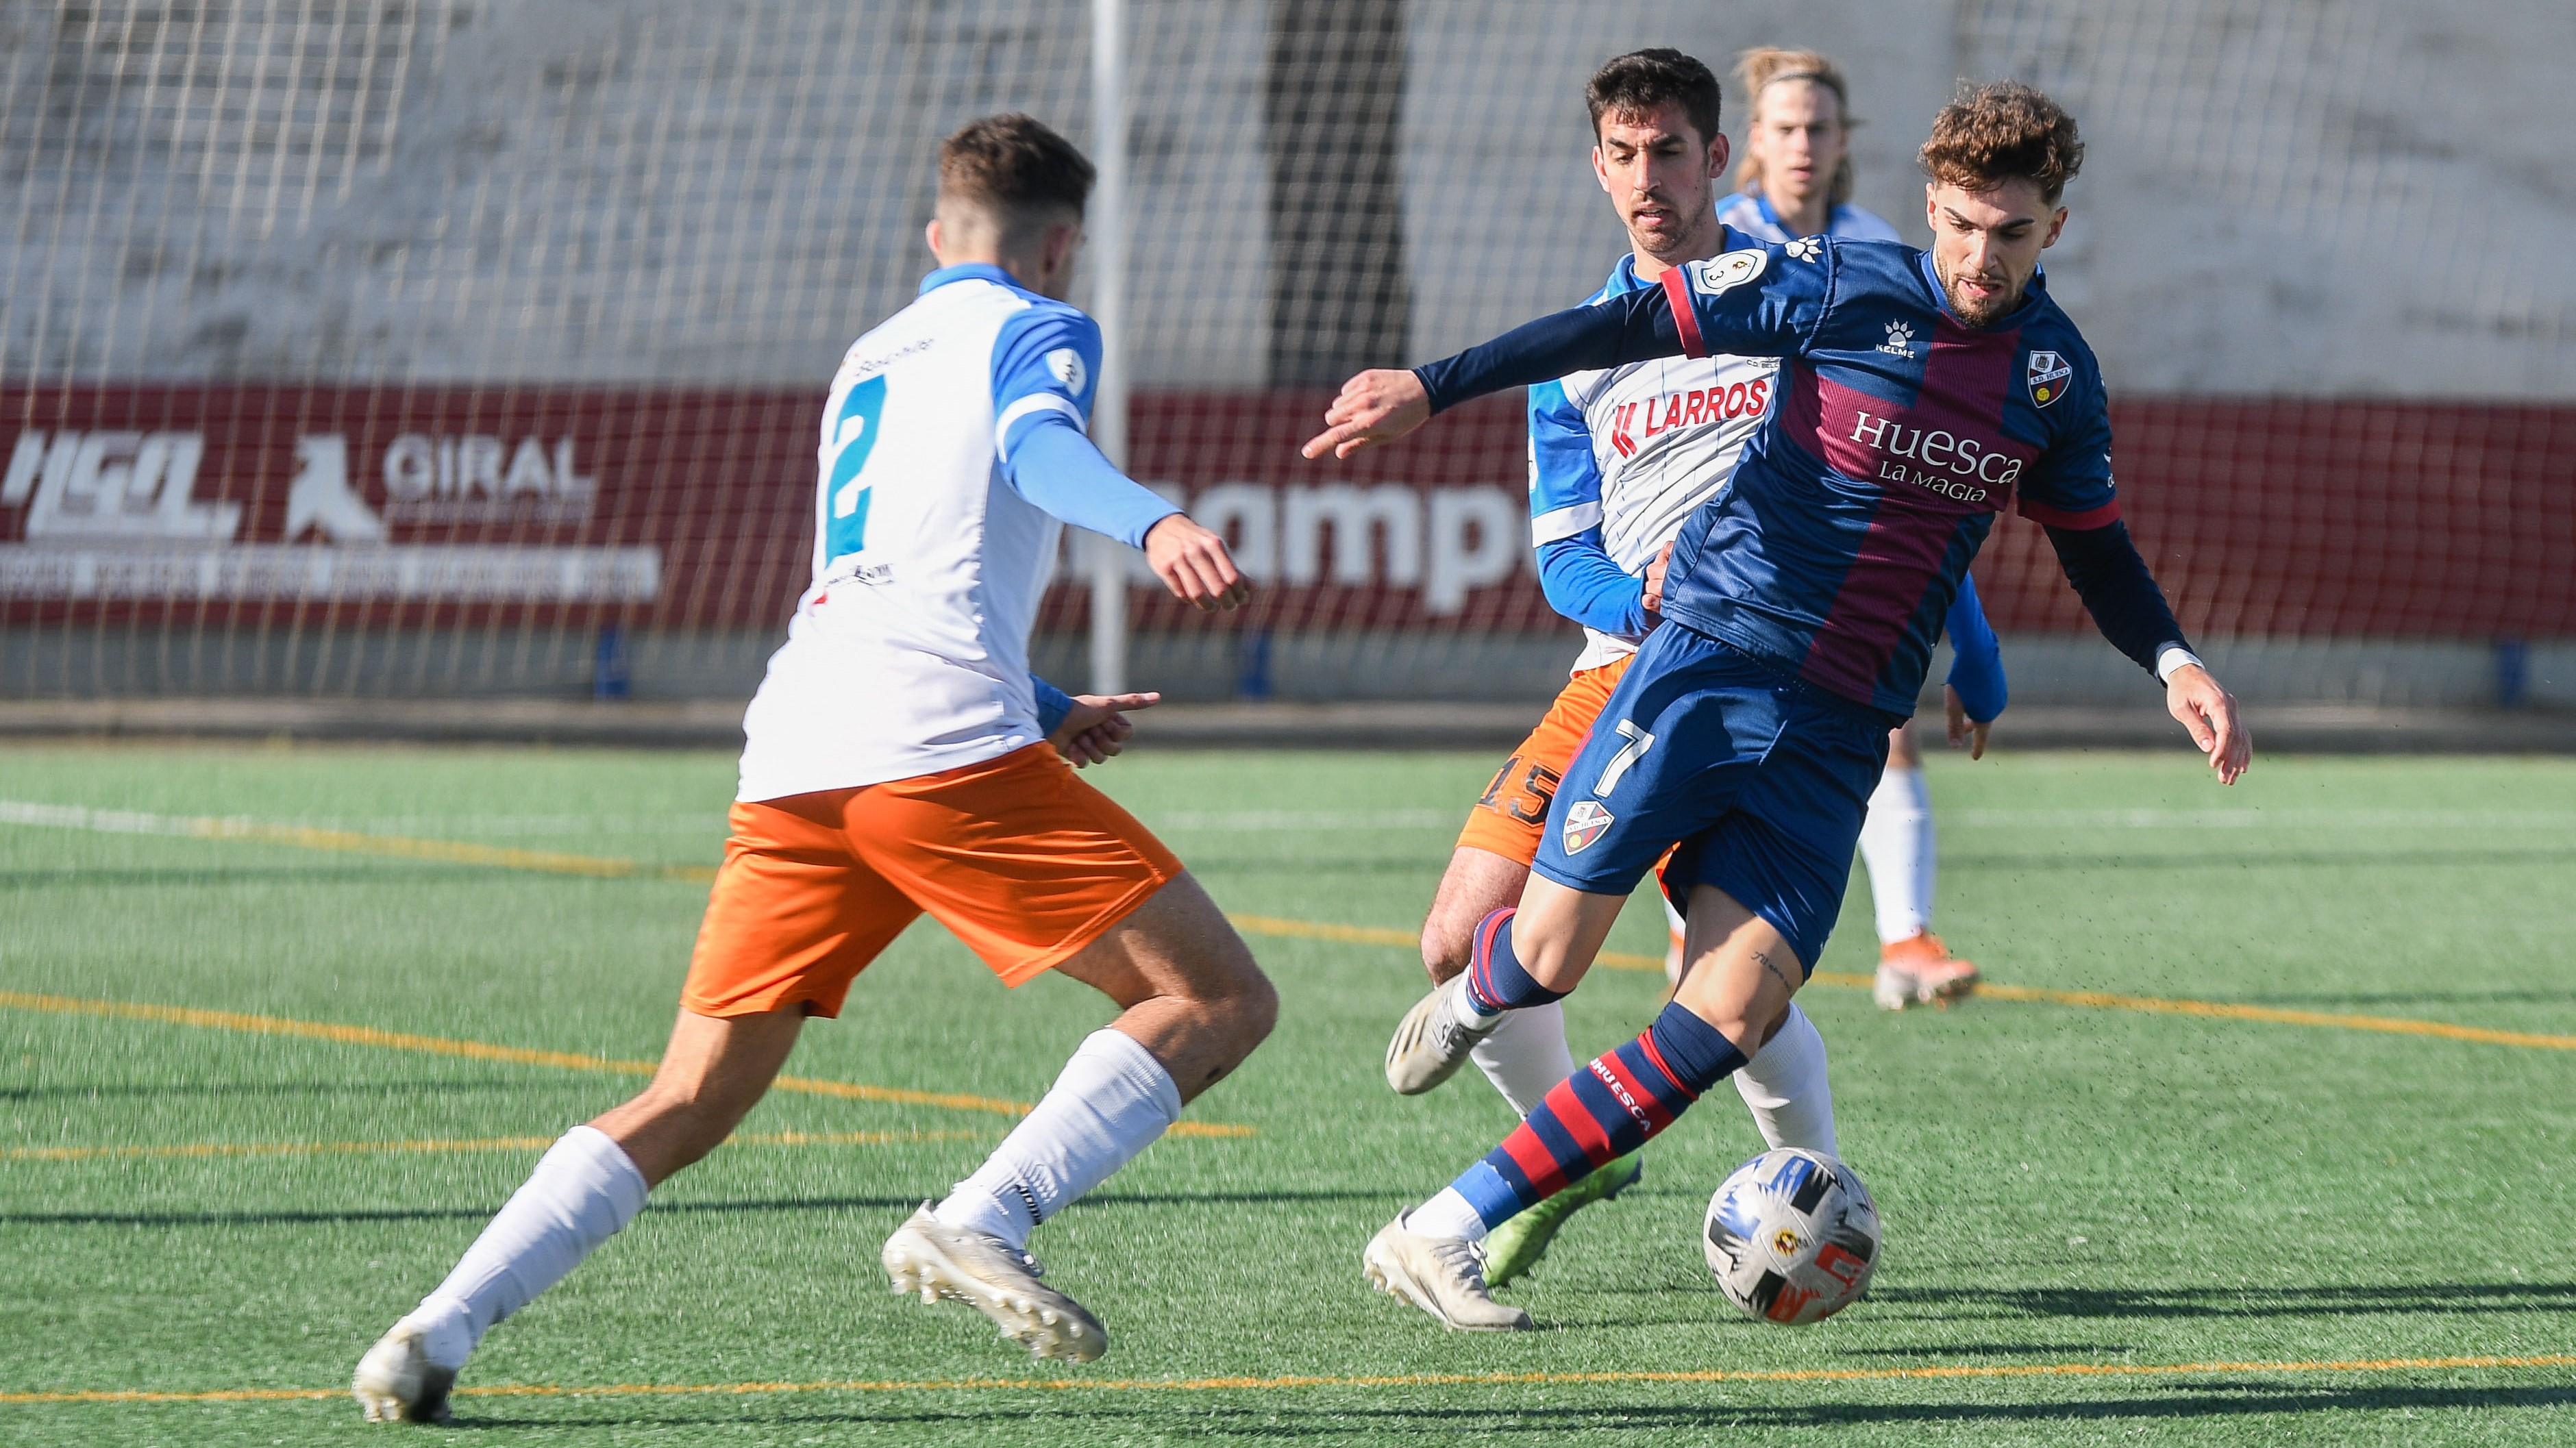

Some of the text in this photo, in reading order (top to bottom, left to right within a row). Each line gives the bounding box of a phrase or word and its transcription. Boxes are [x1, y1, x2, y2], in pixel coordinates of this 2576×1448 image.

[1875, 343, 1915, 359] KELME
[1645, 379, 1769, 438] LARROS
[382, 432, 595, 499] GIRAL
[825, 373, 887, 570] 2
[1849, 410, 2022, 484] Huesca
[1879, 460, 1907, 482] La
[1476, 755, 1563, 828] 15
[1594, 718, 1655, 798] 7
